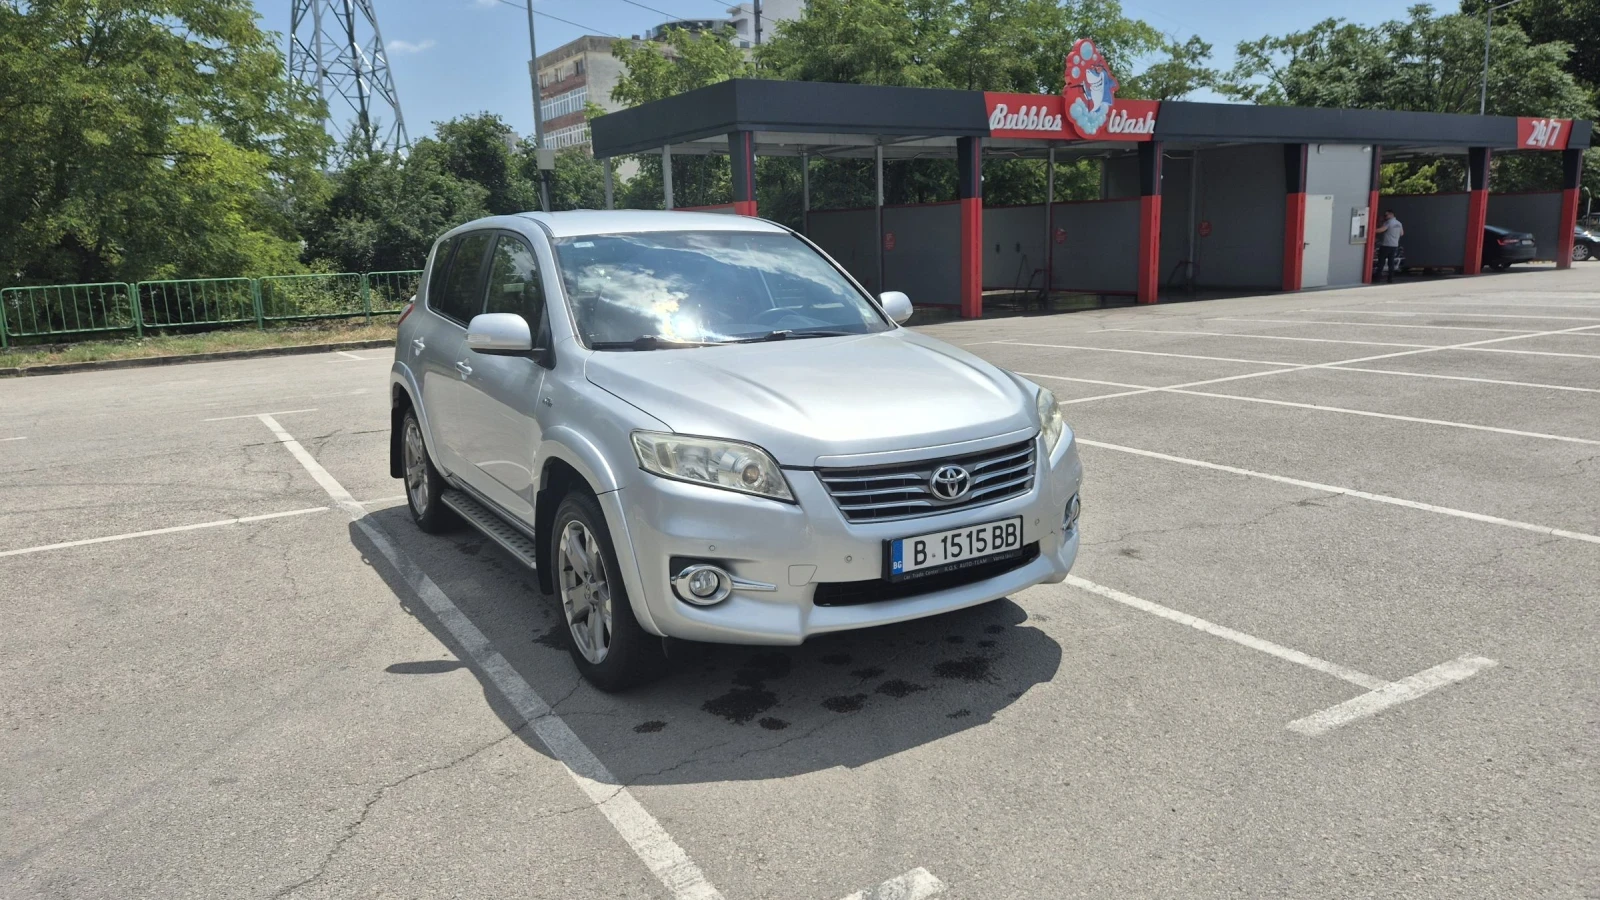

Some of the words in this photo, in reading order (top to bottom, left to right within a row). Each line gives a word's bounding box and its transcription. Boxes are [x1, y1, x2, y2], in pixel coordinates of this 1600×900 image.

[989, 103, 1062, 131] Bubbles
[1107, 109, 1156, 134] Wash
[1526, 119, 1562, 148] 24/7
[892, 560, 903, 570] BG
[914, 540, 928, 566] B
